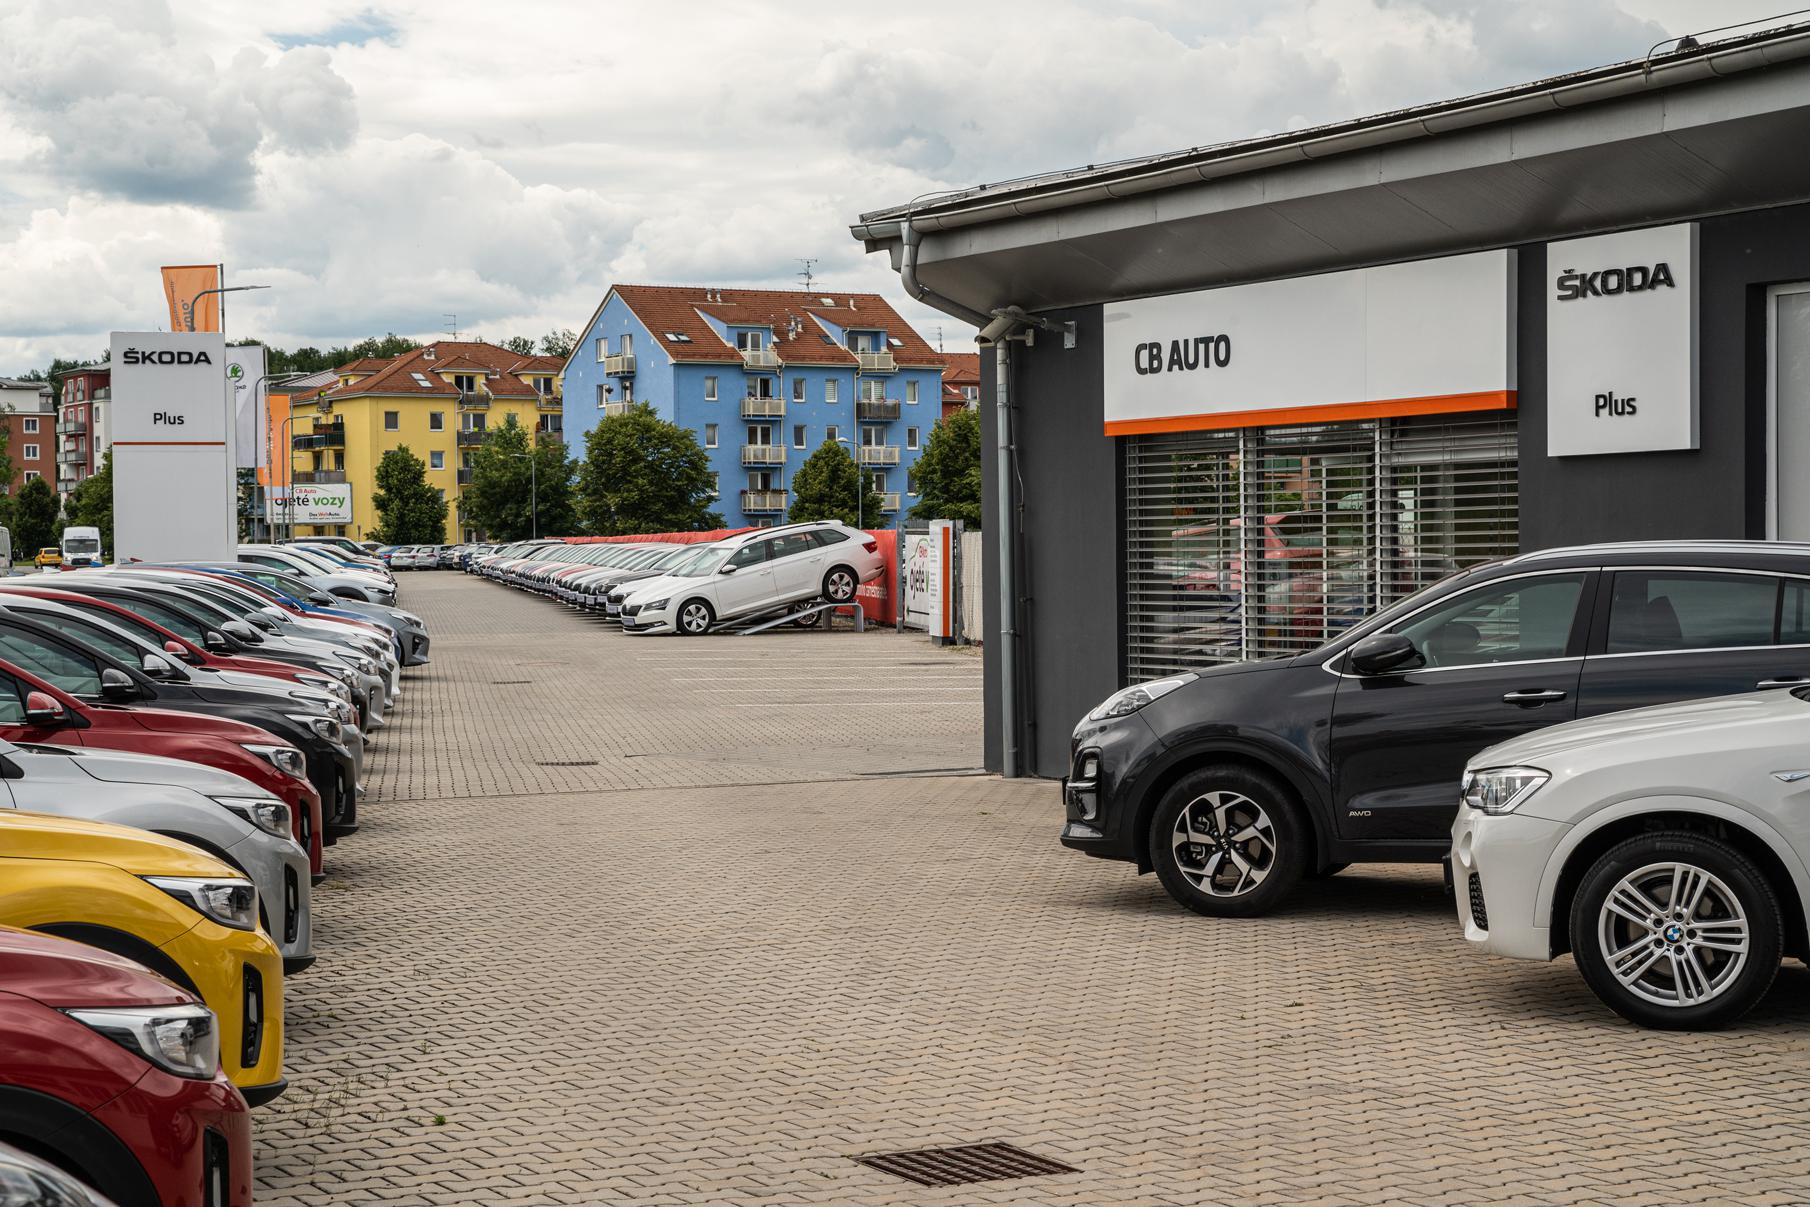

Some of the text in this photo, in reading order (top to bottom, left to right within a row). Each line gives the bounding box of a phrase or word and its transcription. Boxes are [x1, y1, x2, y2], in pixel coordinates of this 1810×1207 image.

[1557, 263, 1675, 301] ŠKODA
[123, 347, 212, 365] ŠKODA
[1135, 334, 1231, 375] CB AUTO
[1595, 391, 1637, 417] Plus
[153, 411, 185, 425] Plus
[313, 496, 345, 508] vozy
